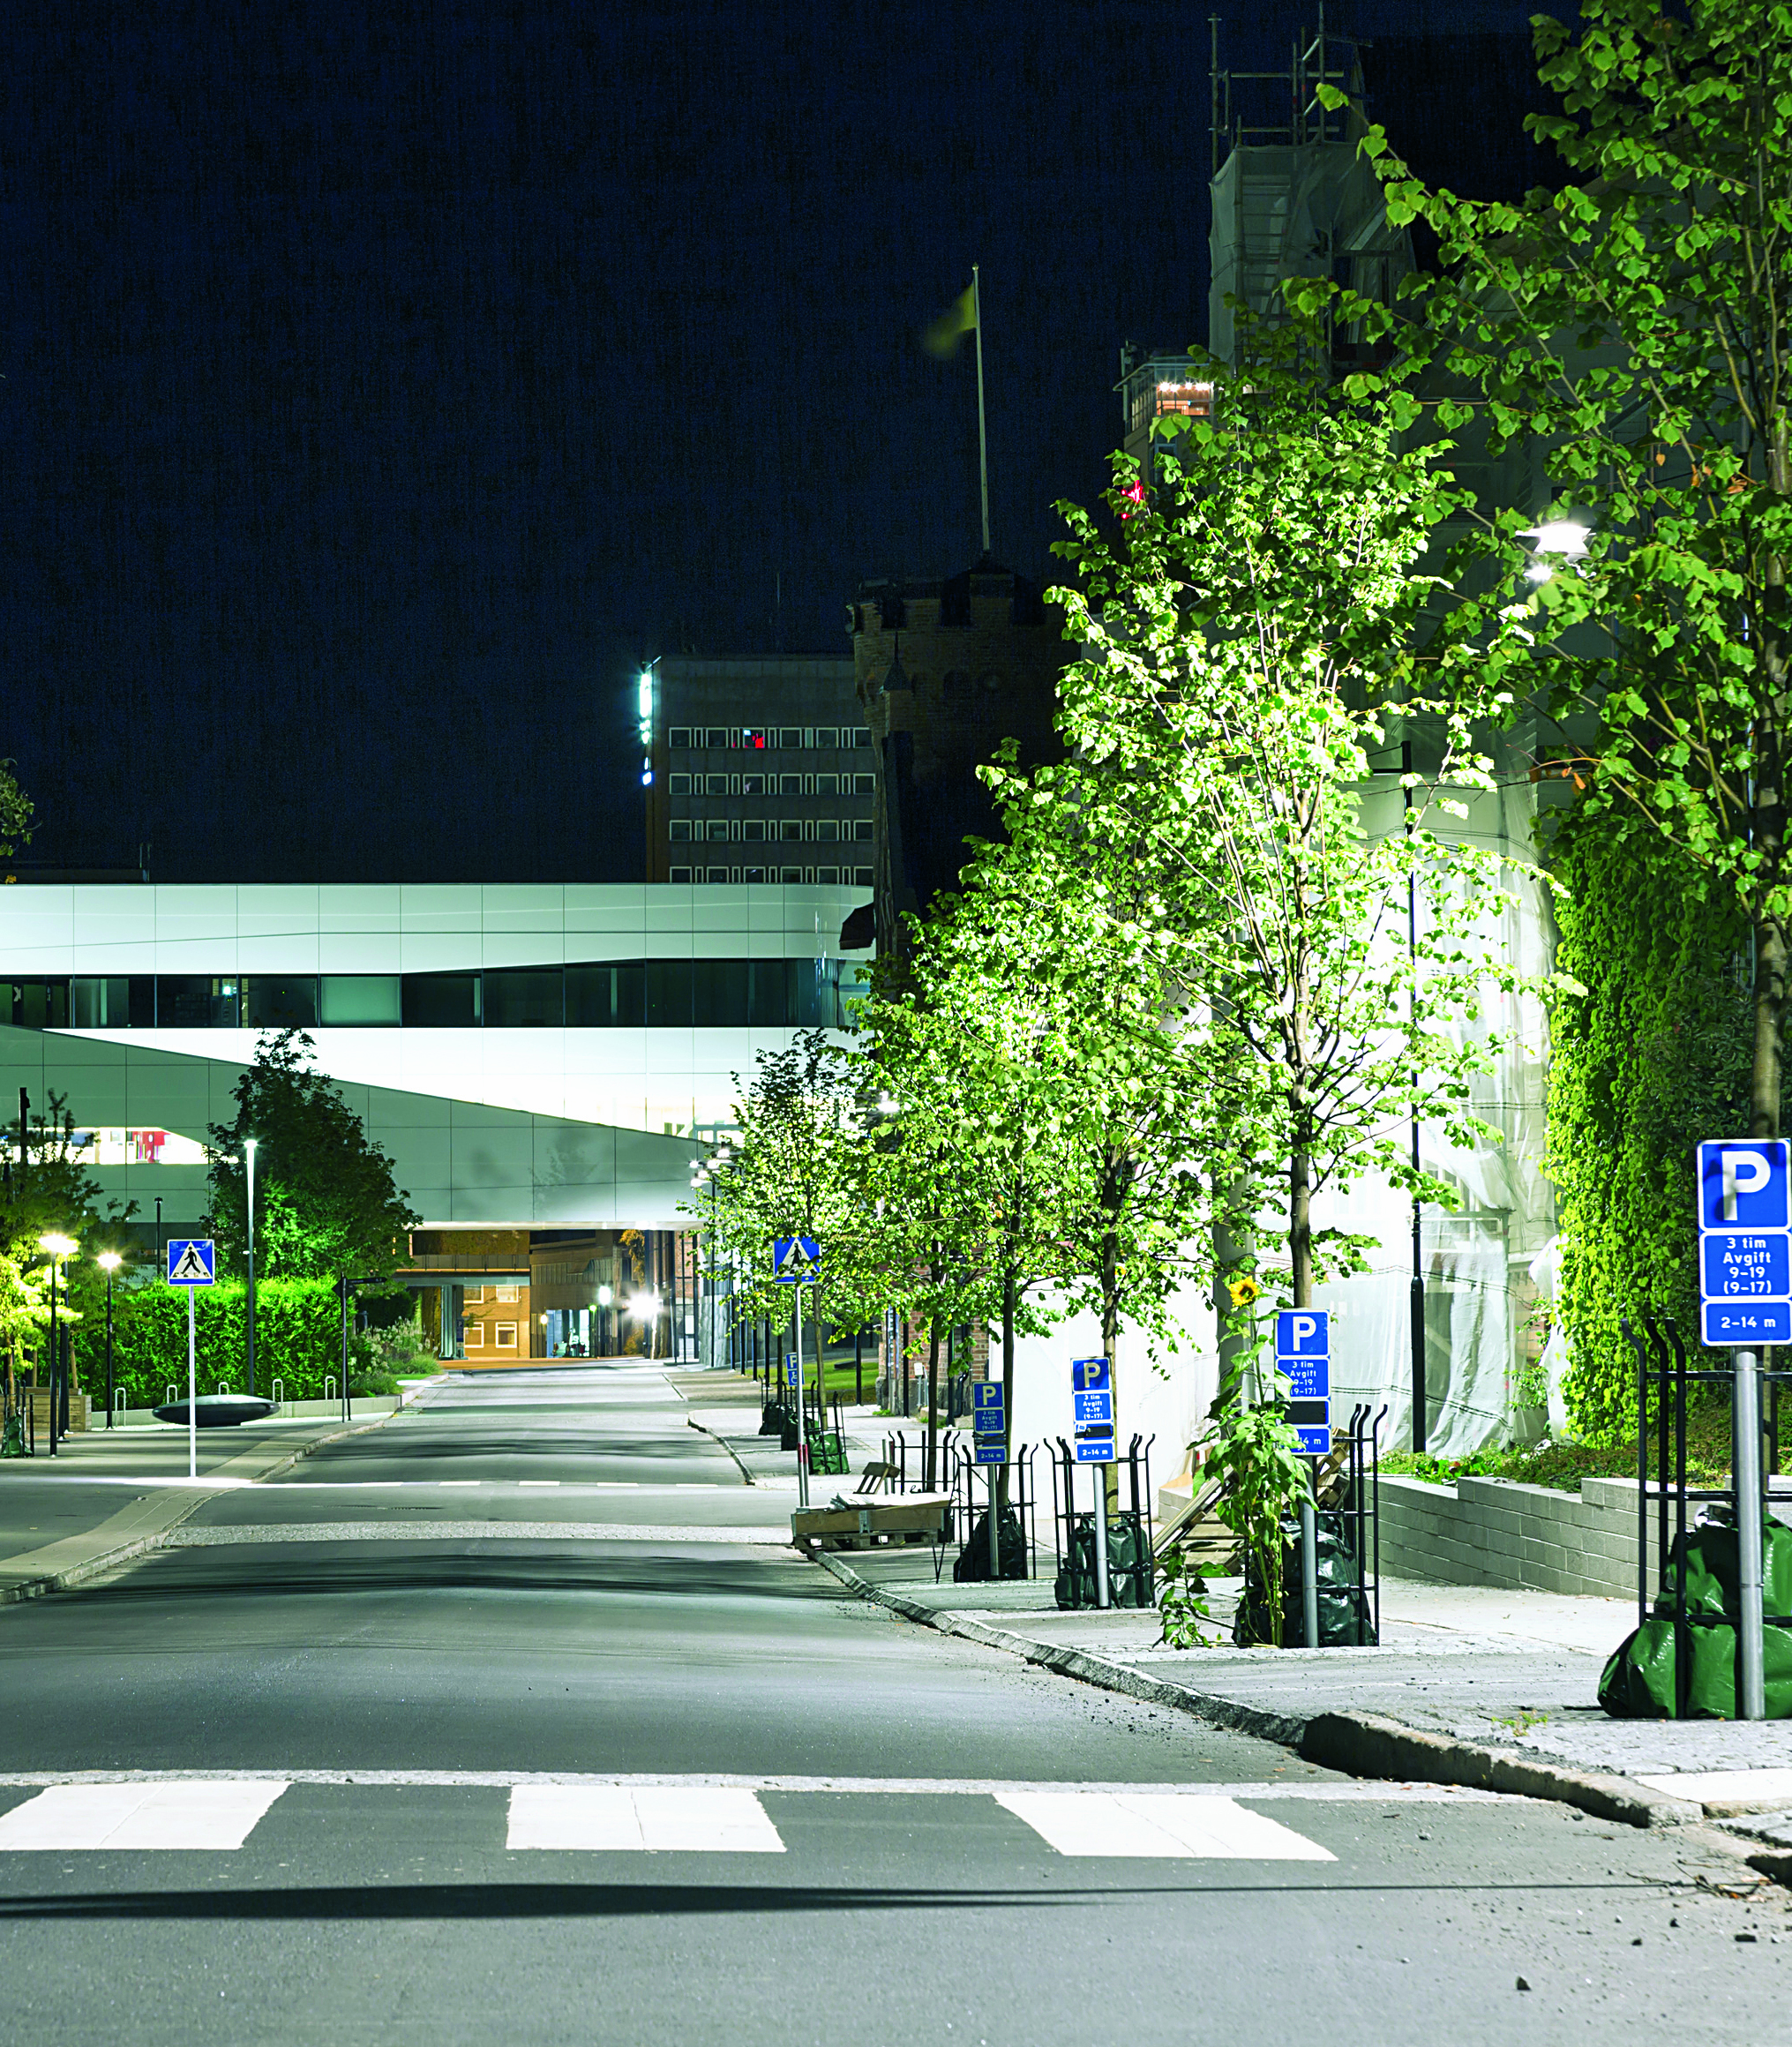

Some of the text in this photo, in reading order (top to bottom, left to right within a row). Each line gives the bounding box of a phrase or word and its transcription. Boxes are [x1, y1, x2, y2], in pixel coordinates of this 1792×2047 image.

[1721, 1151, 1771, 1220] P
[1727, 1237, 1766, 1248] 3 tim
[1723, 1251, 1771, 1266] Avgift
[1729, 1266, 1766, 1278] 9-19
[1723, 1280, 1772, 1294] (9-17)
[1721, 1316, 1776, 1329] 2-14 m
[1293, 1316, 1316, 1351] P
[1083, 1362, 1101, 1388] P
[982, 1385, 996, 1406] P
